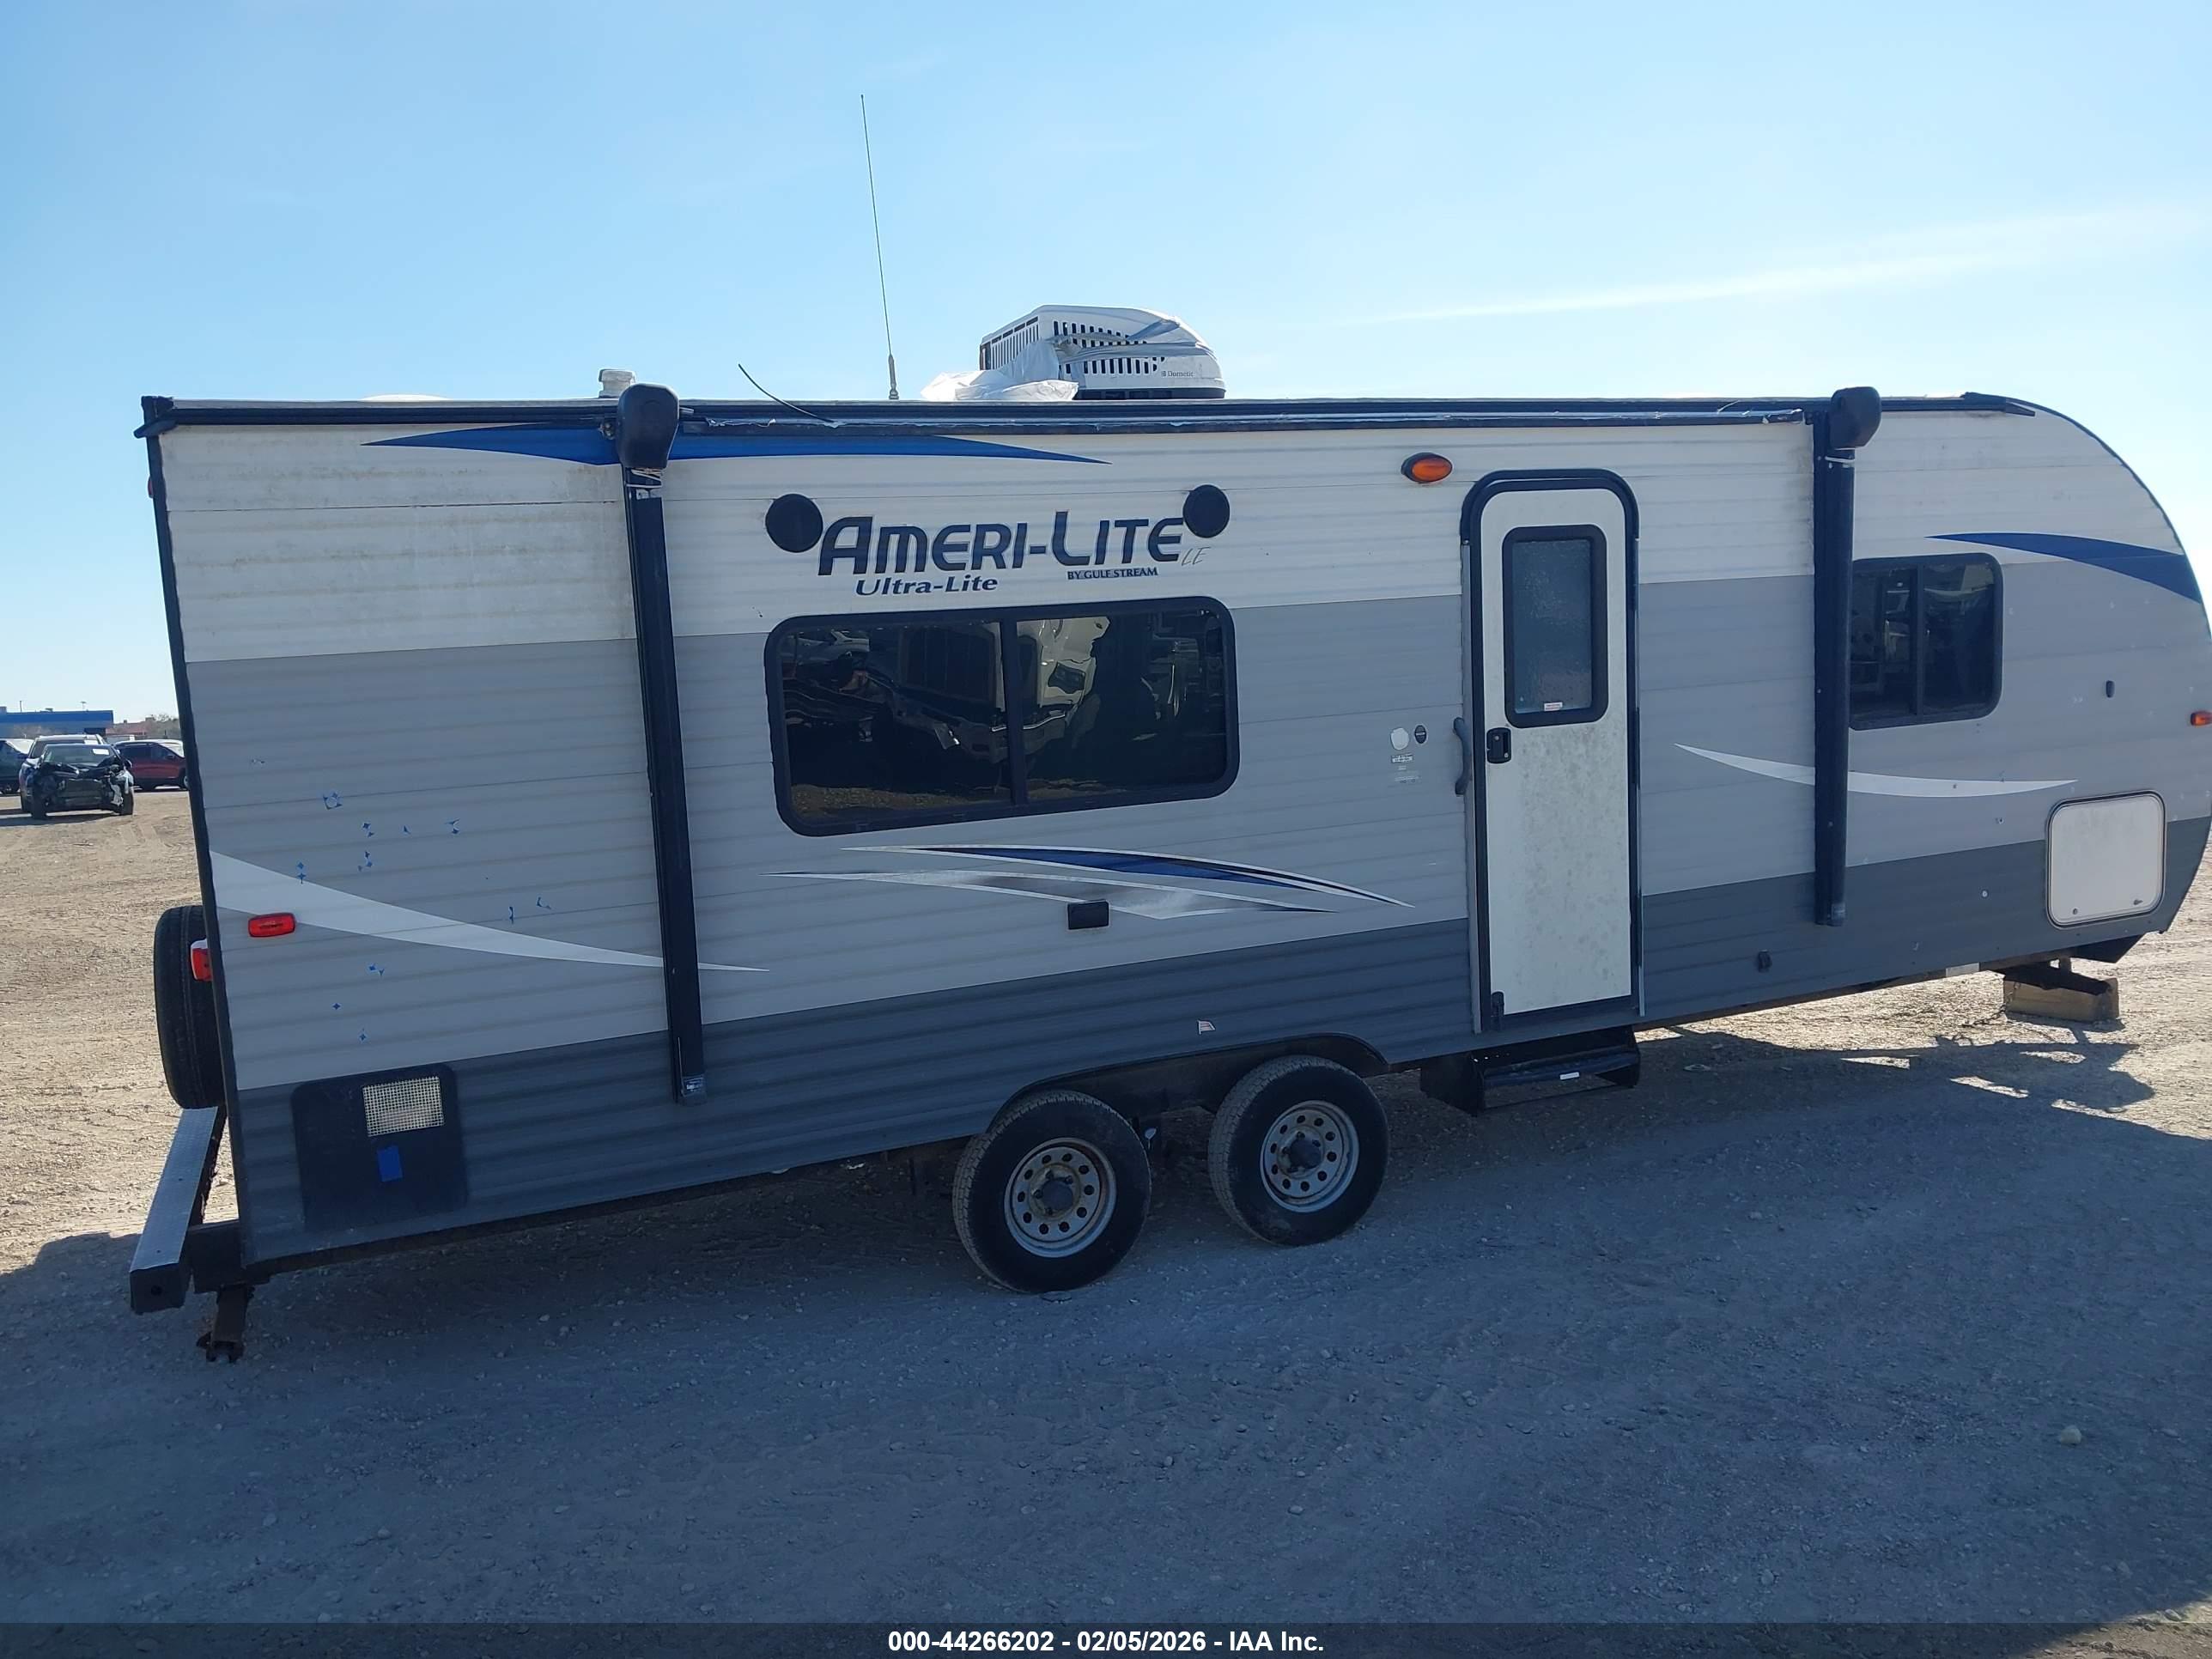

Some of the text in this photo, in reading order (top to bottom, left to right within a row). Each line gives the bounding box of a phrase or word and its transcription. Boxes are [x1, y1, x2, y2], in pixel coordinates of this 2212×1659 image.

[1067, 567, 1158, 580] BY GULF STREAM
[855, 574, 999, 596] Ultra-Lite
